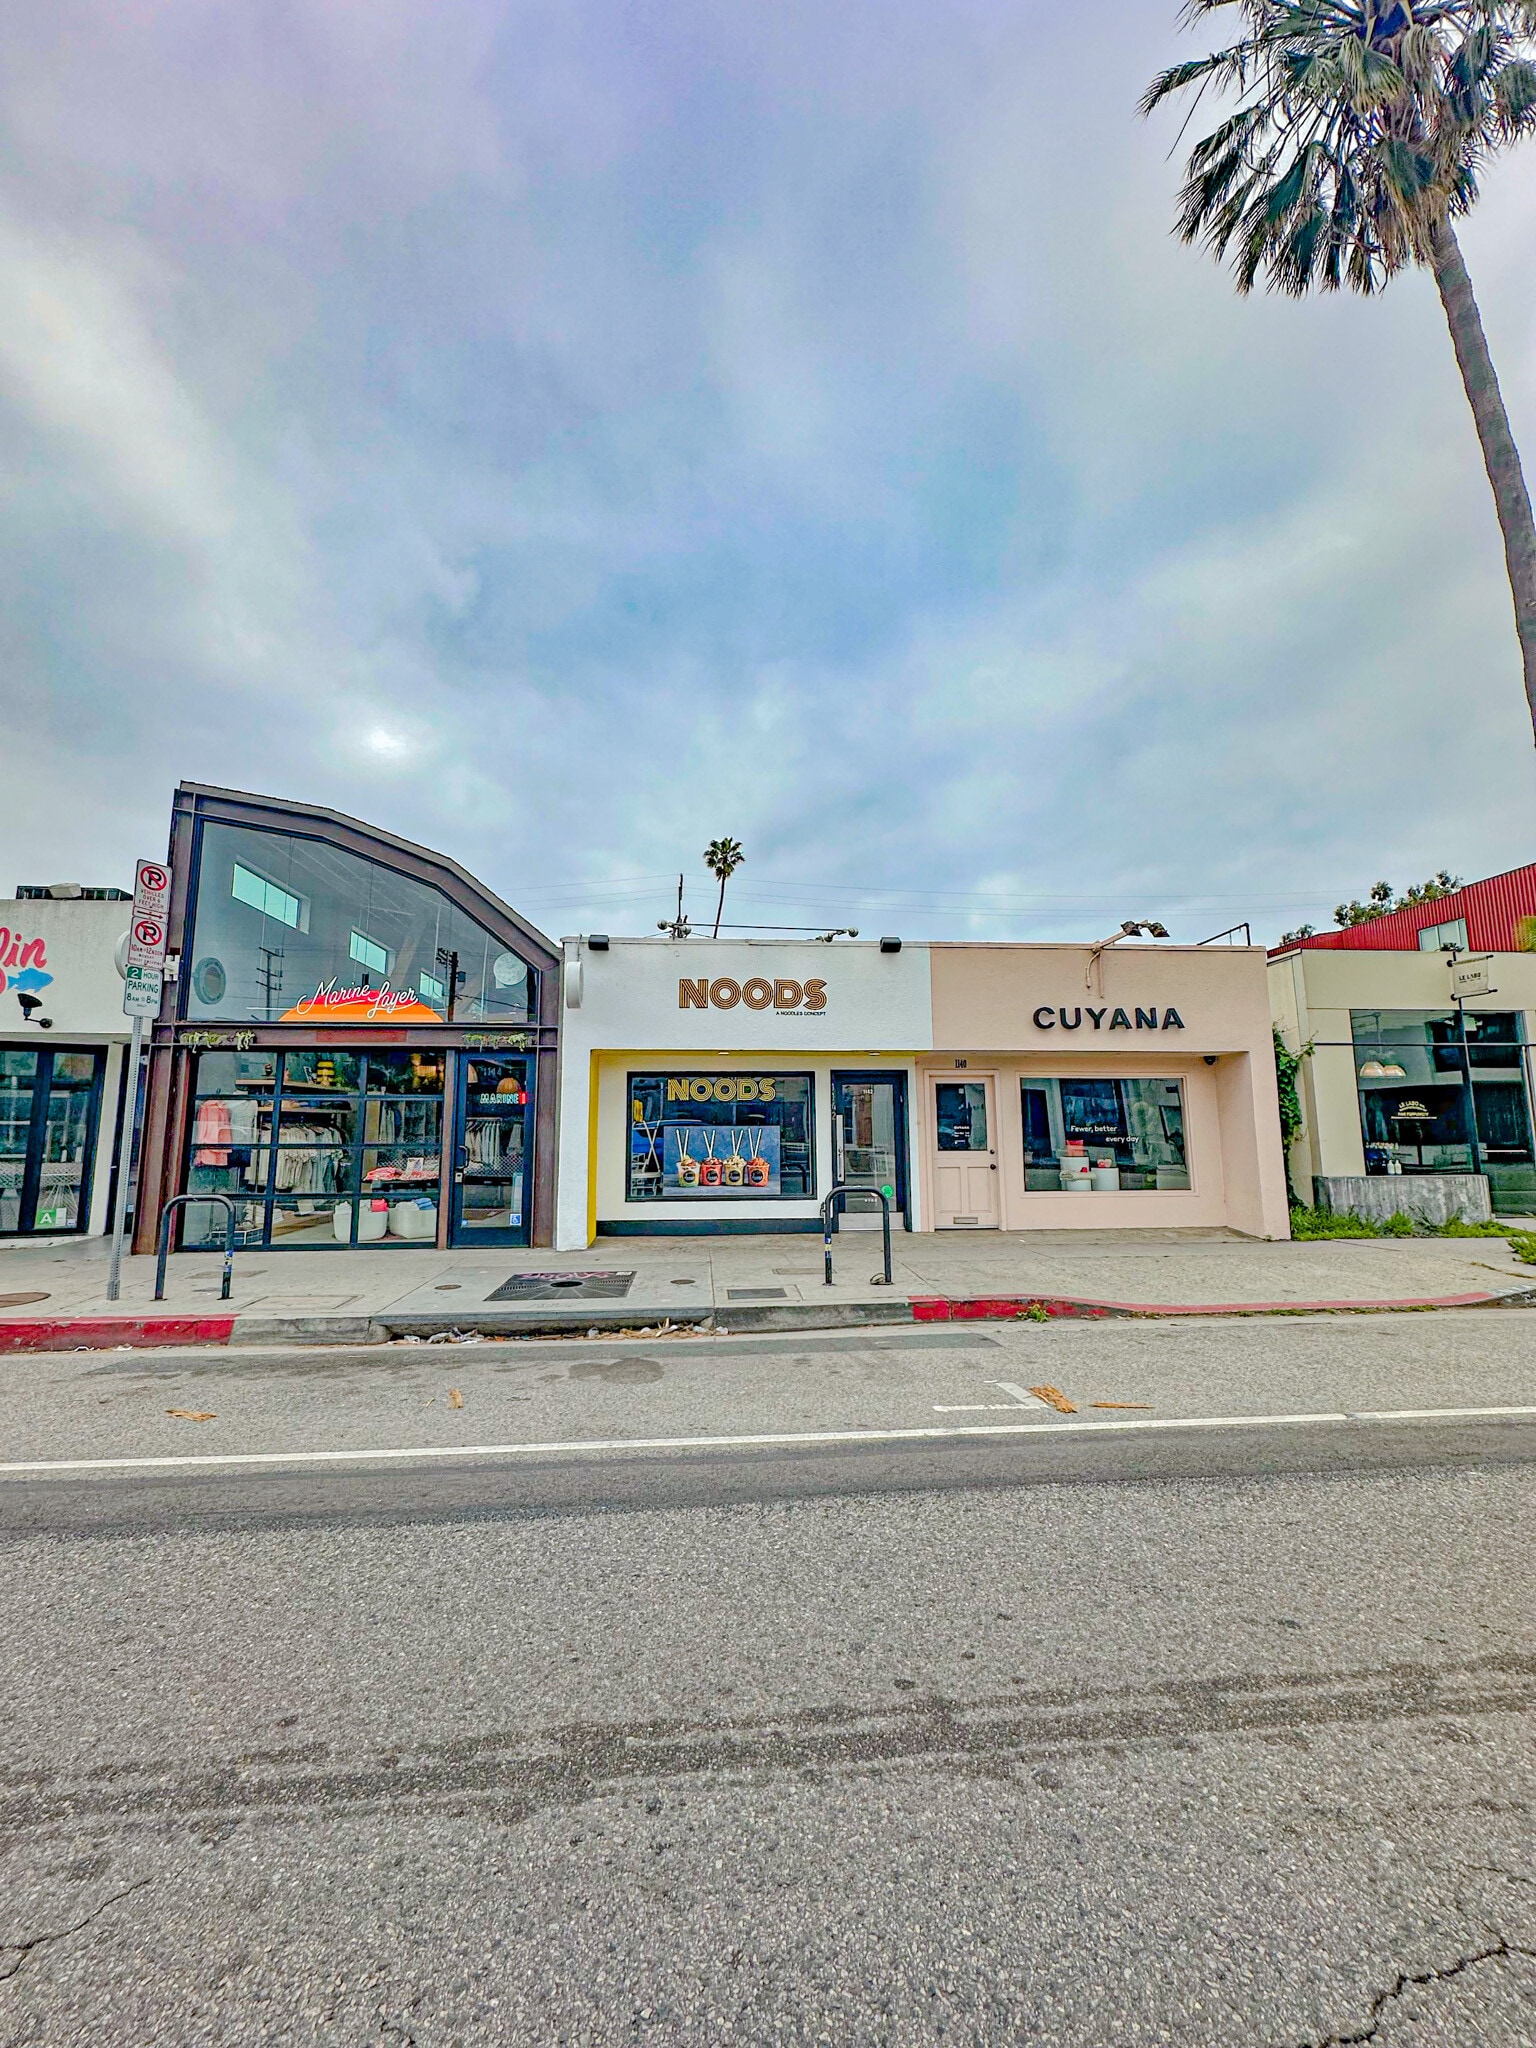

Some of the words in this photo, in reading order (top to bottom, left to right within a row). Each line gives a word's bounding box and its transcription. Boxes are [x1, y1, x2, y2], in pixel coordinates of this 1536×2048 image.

[132, 968, 139, 978] 2
[143, 972, 159, 980] HOUR
[128, 980, 159, 994] PARKING
[296, 976, 371, 1015] Marine
[367, 979, 419, 1019] Layer
[678, 977, 828, 1011] NOODS
[1032, 1006, 1186, 1031] CUYANA
[955, 1059, 967, 1069] 1140
[667, 1077, 776, 1102] NOODS
[479, 1092, 520, 1105] MARINE
[1070, 1125, 1094, 1133] Fewer,
[1105, 1136, 1125, 1144] every
[1125, 1135, 1139, 1144] day
[40, 1212, 53, 1224] A
